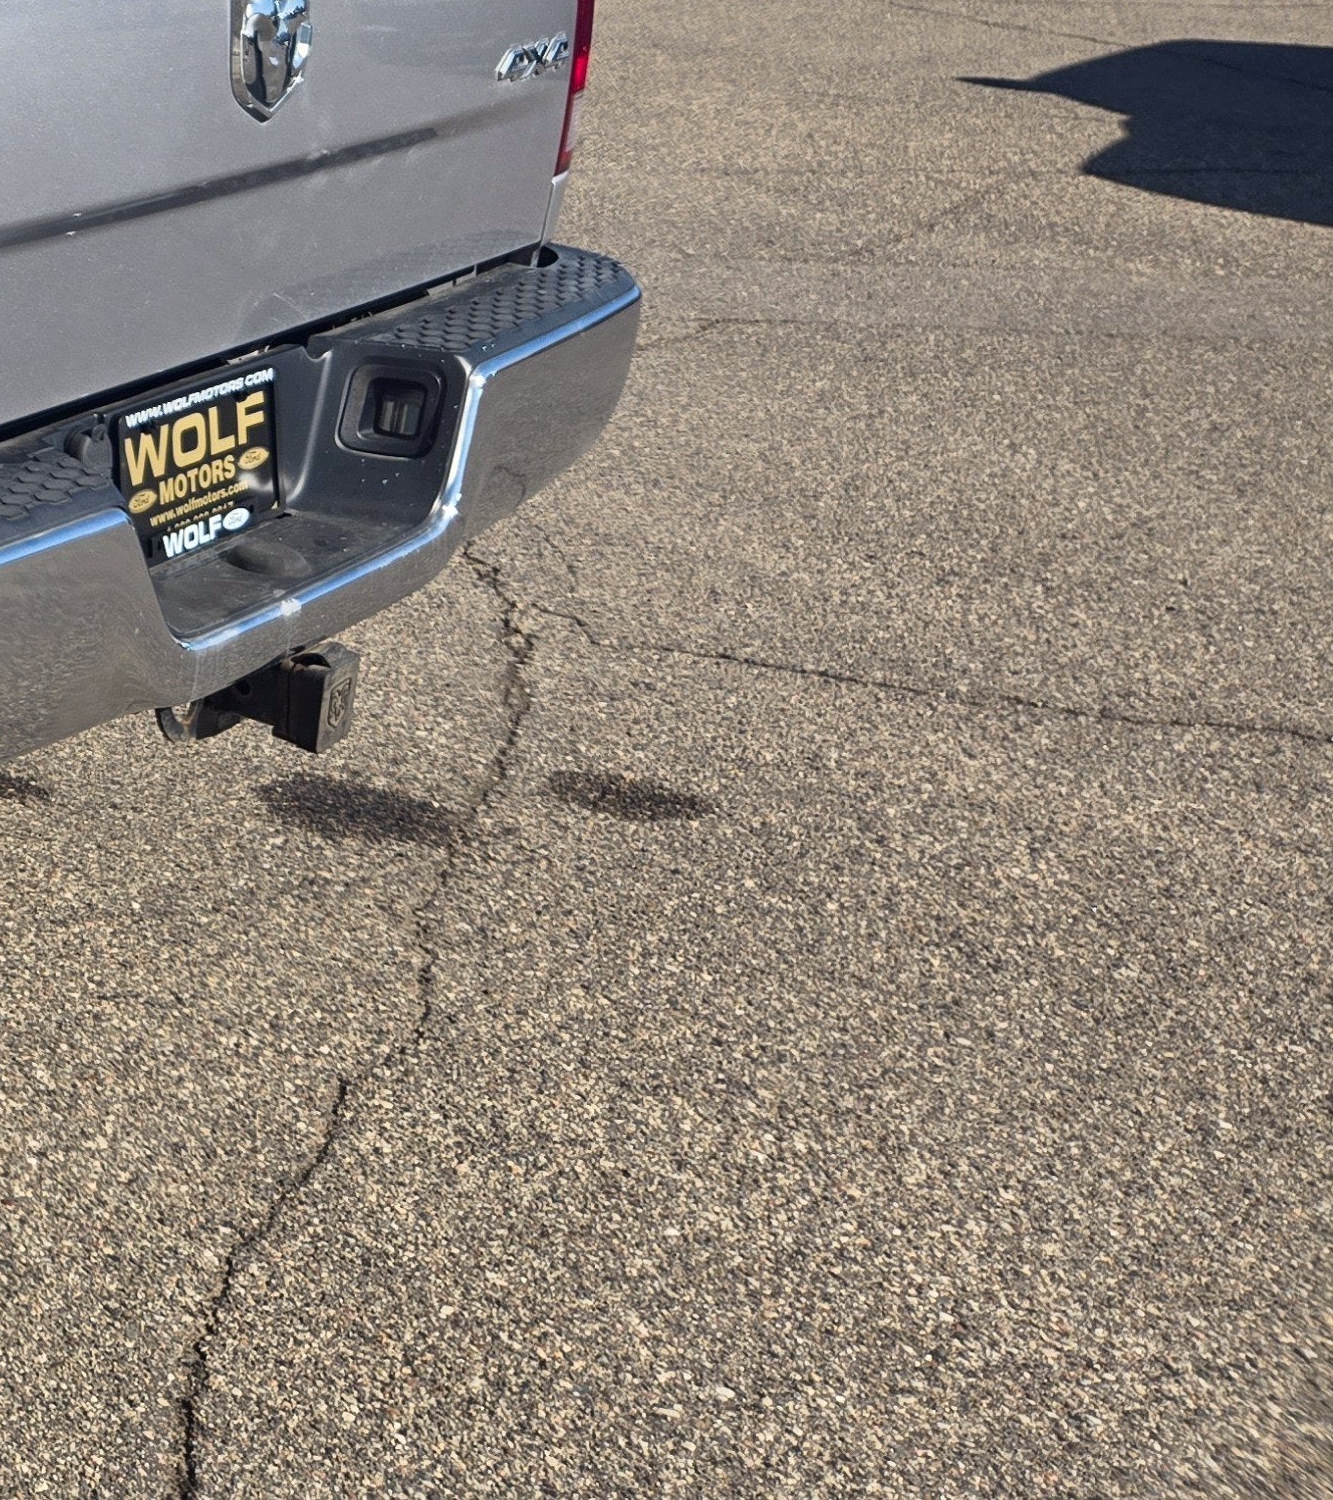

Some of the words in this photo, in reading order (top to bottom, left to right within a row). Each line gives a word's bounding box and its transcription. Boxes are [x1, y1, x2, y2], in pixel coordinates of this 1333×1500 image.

[125, 368, 274, 428] WWW.WOLFMOTORS.COM
[125, 390, 265, 487] WOLF
[150, 479, 249, 527] www.wolfmotors.com
[159, 455, 236, 505] MOTORS
[162, 514, 223, 558] WOLF
